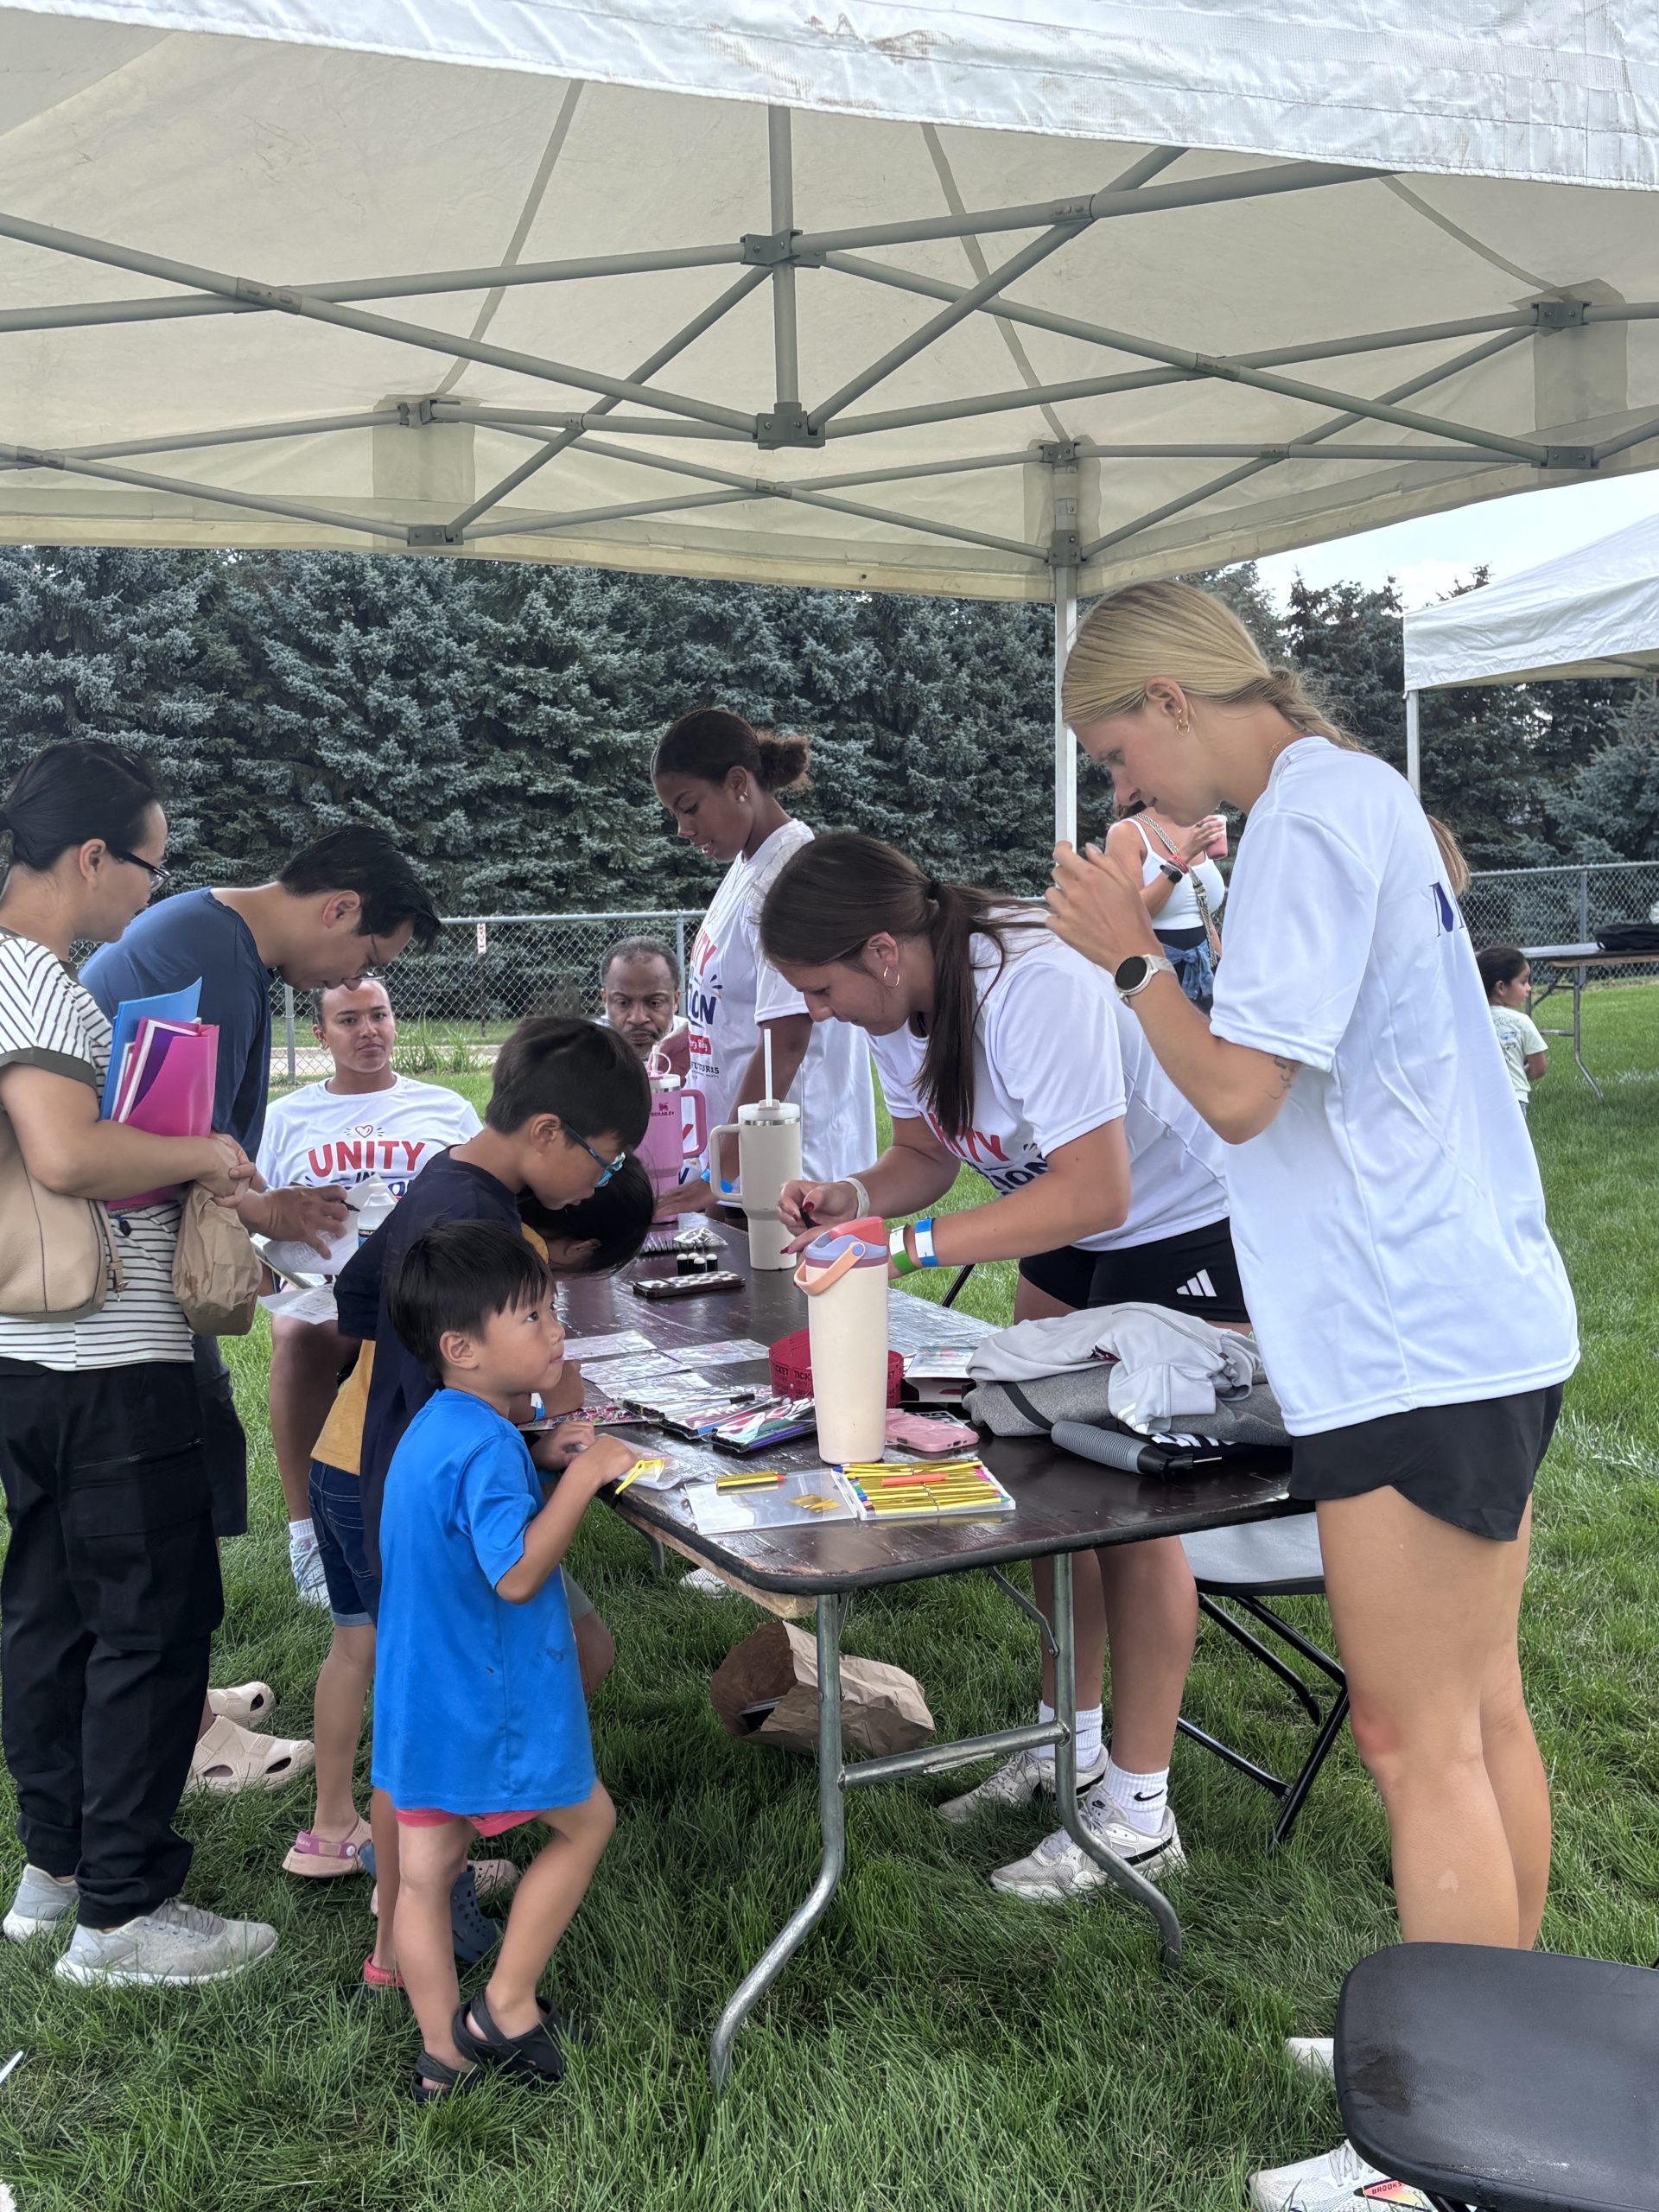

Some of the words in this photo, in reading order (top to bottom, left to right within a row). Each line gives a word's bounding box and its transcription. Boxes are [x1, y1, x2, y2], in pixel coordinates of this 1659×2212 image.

[308, 1141, 425, 1178] UNITY
[794, 1370, 811, 1381] TICK
[1372, 2182, 1402, 2195] BROOKS
